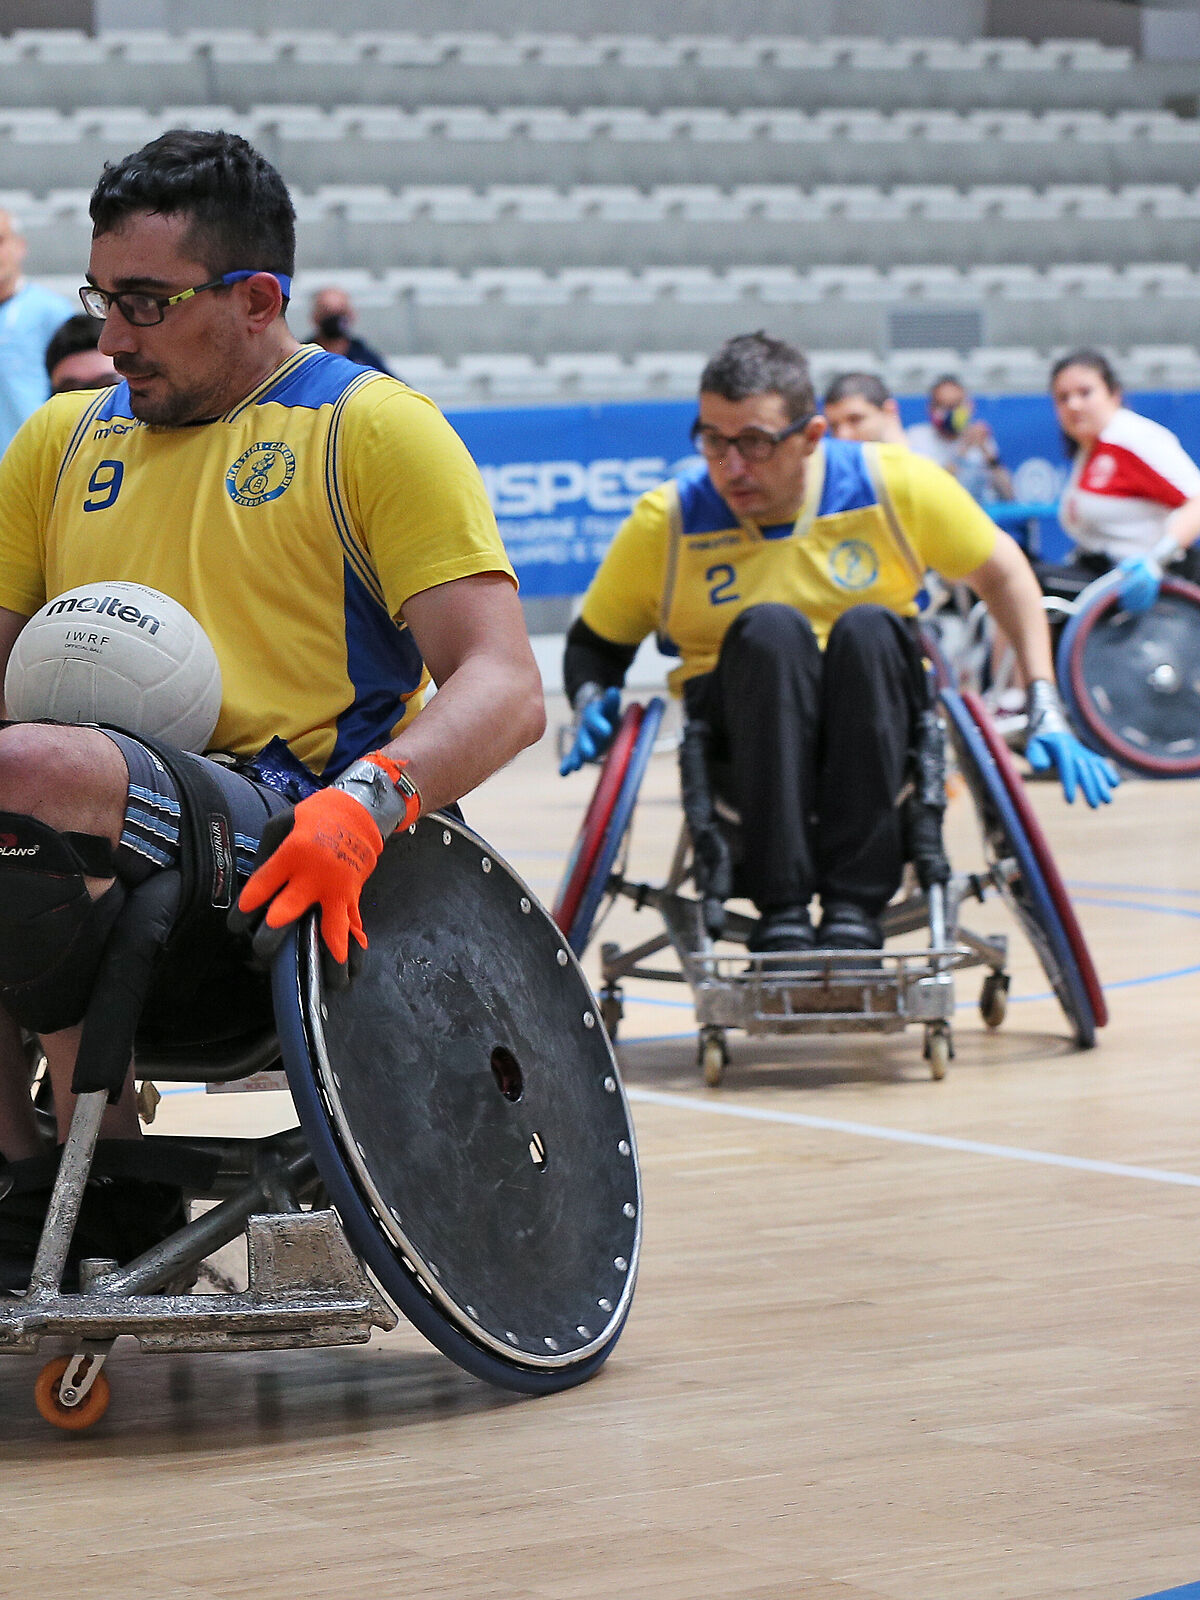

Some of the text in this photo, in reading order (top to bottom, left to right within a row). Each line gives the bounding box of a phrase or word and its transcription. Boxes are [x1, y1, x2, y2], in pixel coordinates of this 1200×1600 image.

[83, 459, 125, 512] 9
[705, 563, 740, 606] 2
[46, 596, 163, 636] molten
[65, 631, 110, 646] IWRF
